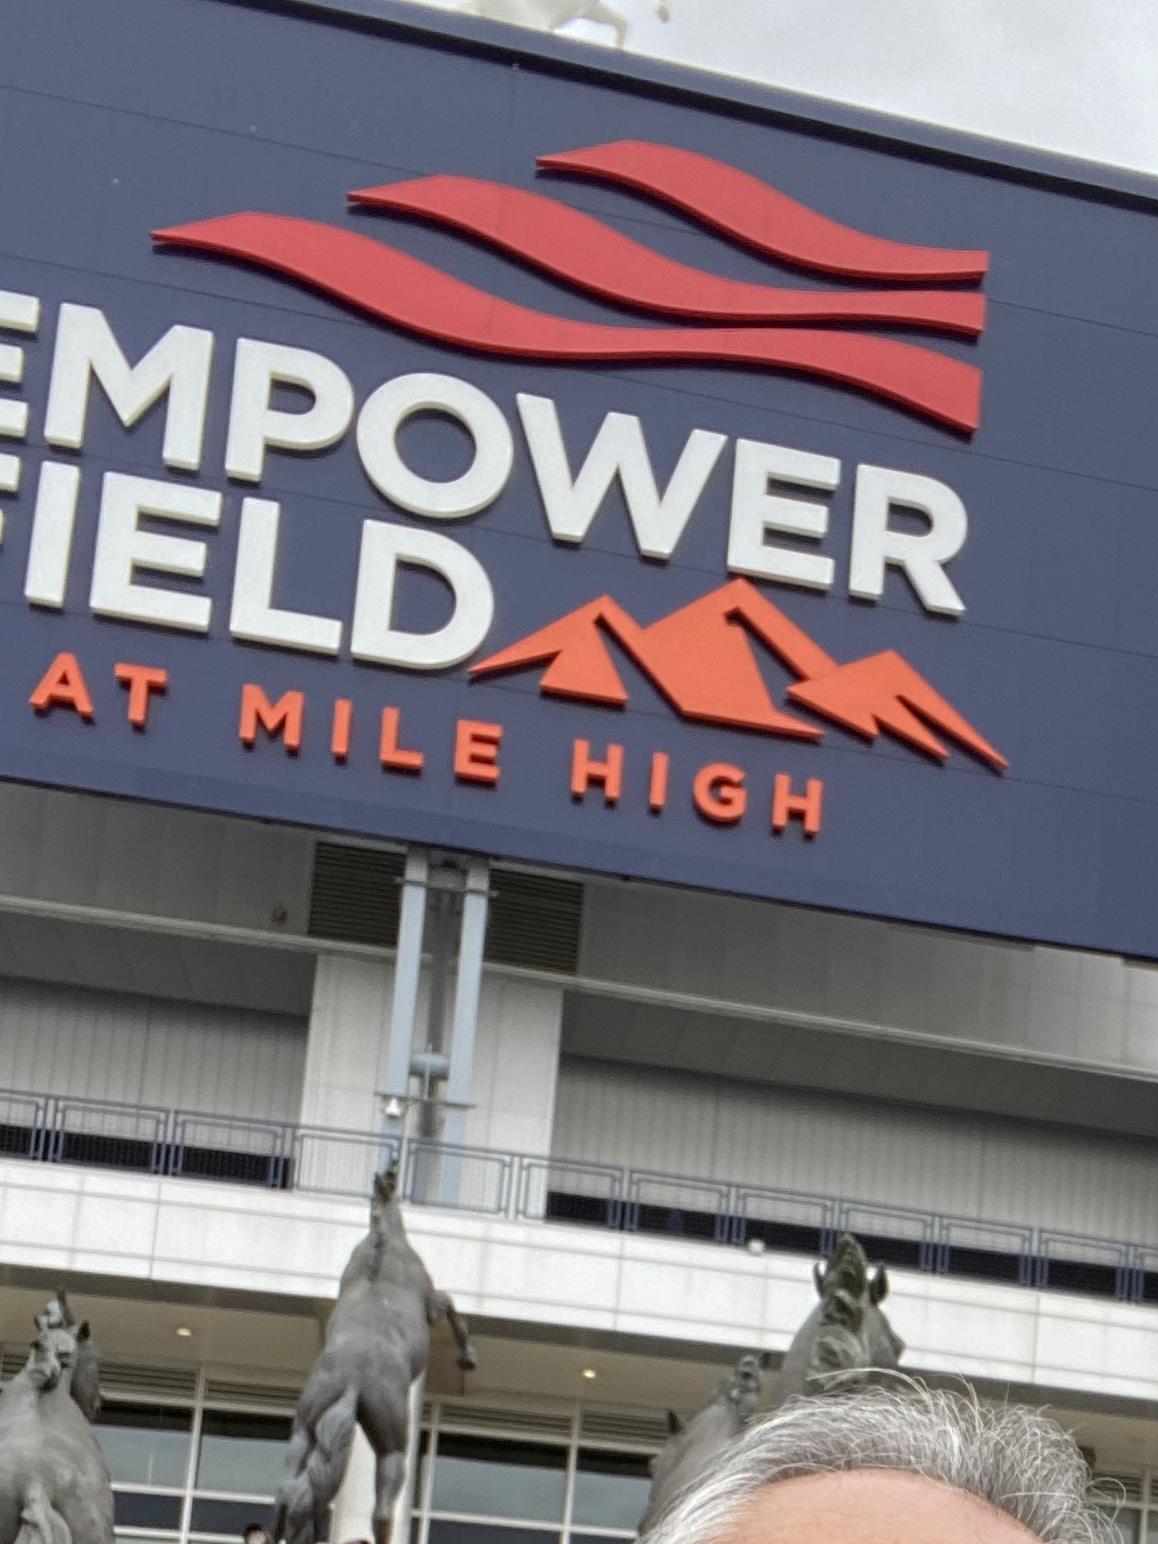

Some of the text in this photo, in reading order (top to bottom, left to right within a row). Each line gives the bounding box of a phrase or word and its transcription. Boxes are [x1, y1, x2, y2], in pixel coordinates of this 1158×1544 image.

[0, 452, 495, 671] IELD
[29, 651, 824, 836] AT MILE HIGH
